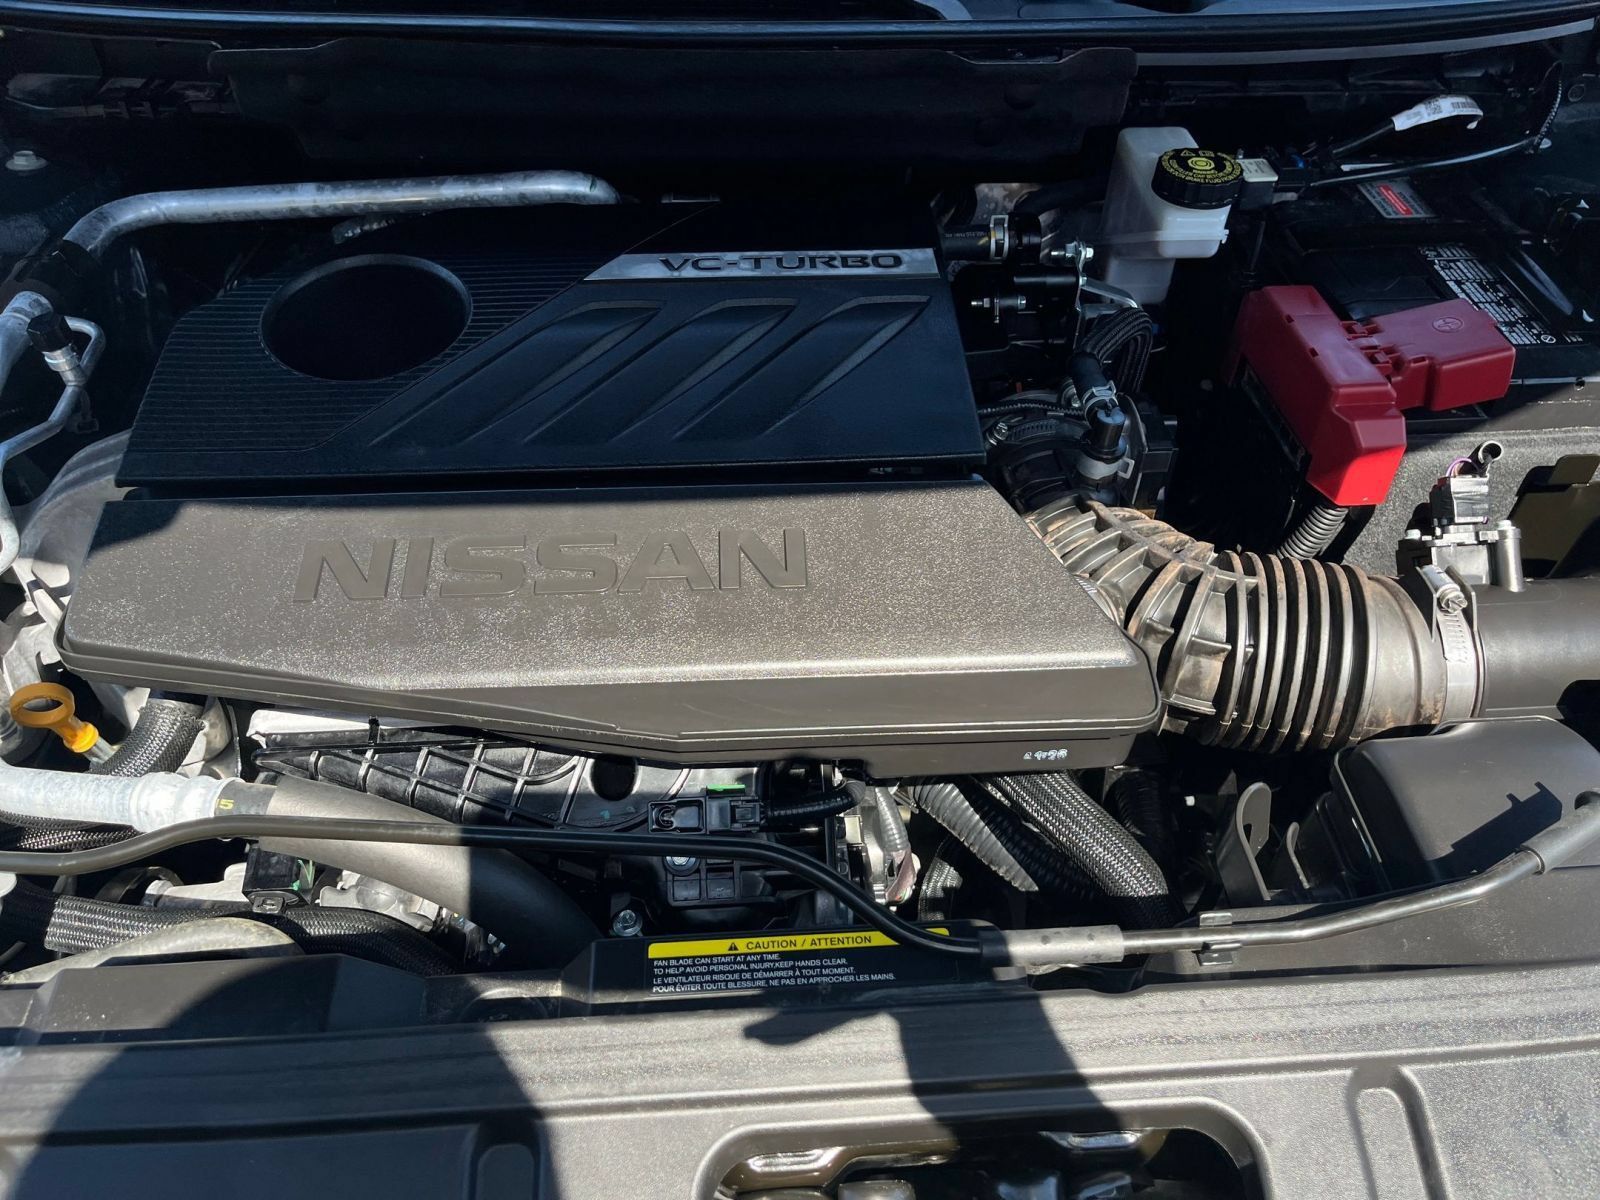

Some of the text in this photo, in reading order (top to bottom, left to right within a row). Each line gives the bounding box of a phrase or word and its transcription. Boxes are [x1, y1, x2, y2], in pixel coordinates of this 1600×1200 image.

[658, 253, 903, 273] VC-TURBO
[293, 528, 808, 600] NISSAN
[746, 940, 797, 950] CAUTION
[810, 935, 872, 947] ATTENTION
[763, 953, 781, 961] TIME.
[663, 975, 711, 984] VENTILATEUR
[712, 973, 740, 981] RISQUE
[753, 970, 794, 979] DÉMARRER
[794, 968, 801, 976] À
[822, 967, 856, 975] MOMENT.
[685, 965, 708, 973] AVOID
[709, 963, 749, 972] PERSONAL
[675, 983, 701, 992] ÉVITER
[702, 982, 726, 990] TOUTE
[808, 975, 855, 984] APPROCHER
[871, 972, 896, 981] MAINS.
